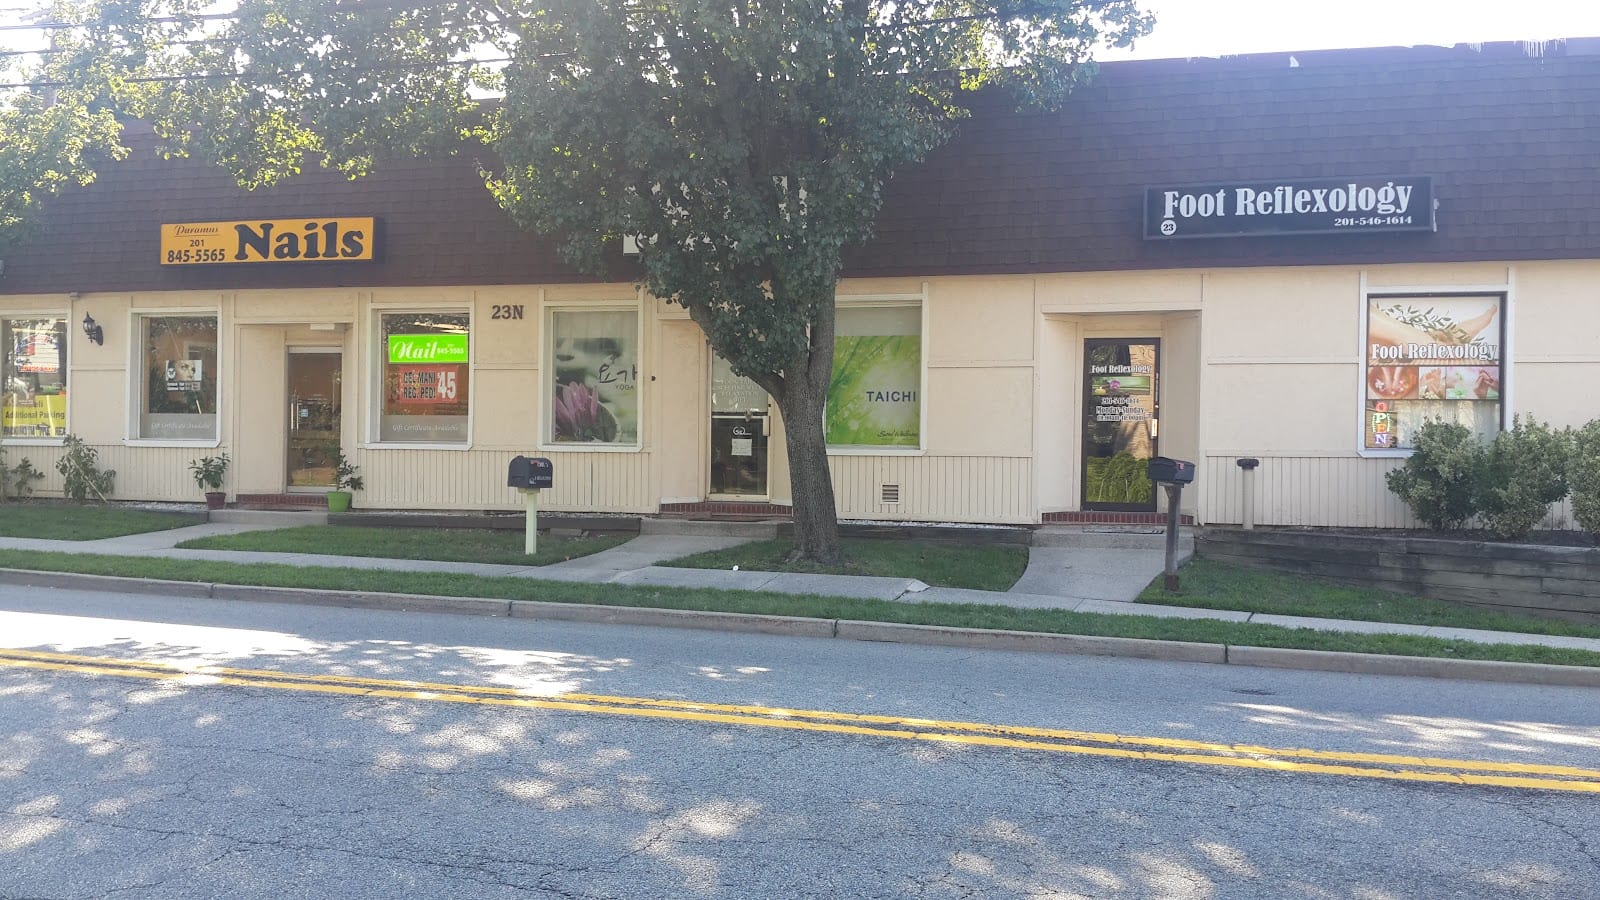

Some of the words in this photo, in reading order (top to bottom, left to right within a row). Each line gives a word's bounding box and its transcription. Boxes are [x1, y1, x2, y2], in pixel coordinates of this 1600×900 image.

[1163, 189, 1225, 218] Foot
[1235, 182, 1412, 215] Reflexology
[1162, 223, 1175, 233] 23
[1334, 215, 1412, 227] 201-546-1614
[174, 225, 219, 236] Paramus
[190, 239, 205, 247] 201
[234, 222, 364, 260] Nails
[167, 248, 226, 263] 845-5565
[491, 305, 524, 320] 23N
[393, 341, 437, 359] Nail
[1372, 343, 1404, 359] Foot
[1408, 343, 1497, 361] Reflexology
[1092, 365, 1107, 374] Foot
[1109, 365, 1150, 375] Reflexology
[418, 371, 436, 384] MANI
[437, 371, 457, 399] 45
[403, 387, 418, 399] REG.
[866, 391, 916, 402] TAICHI
[1374, 402, 1389, 445] OPEN
